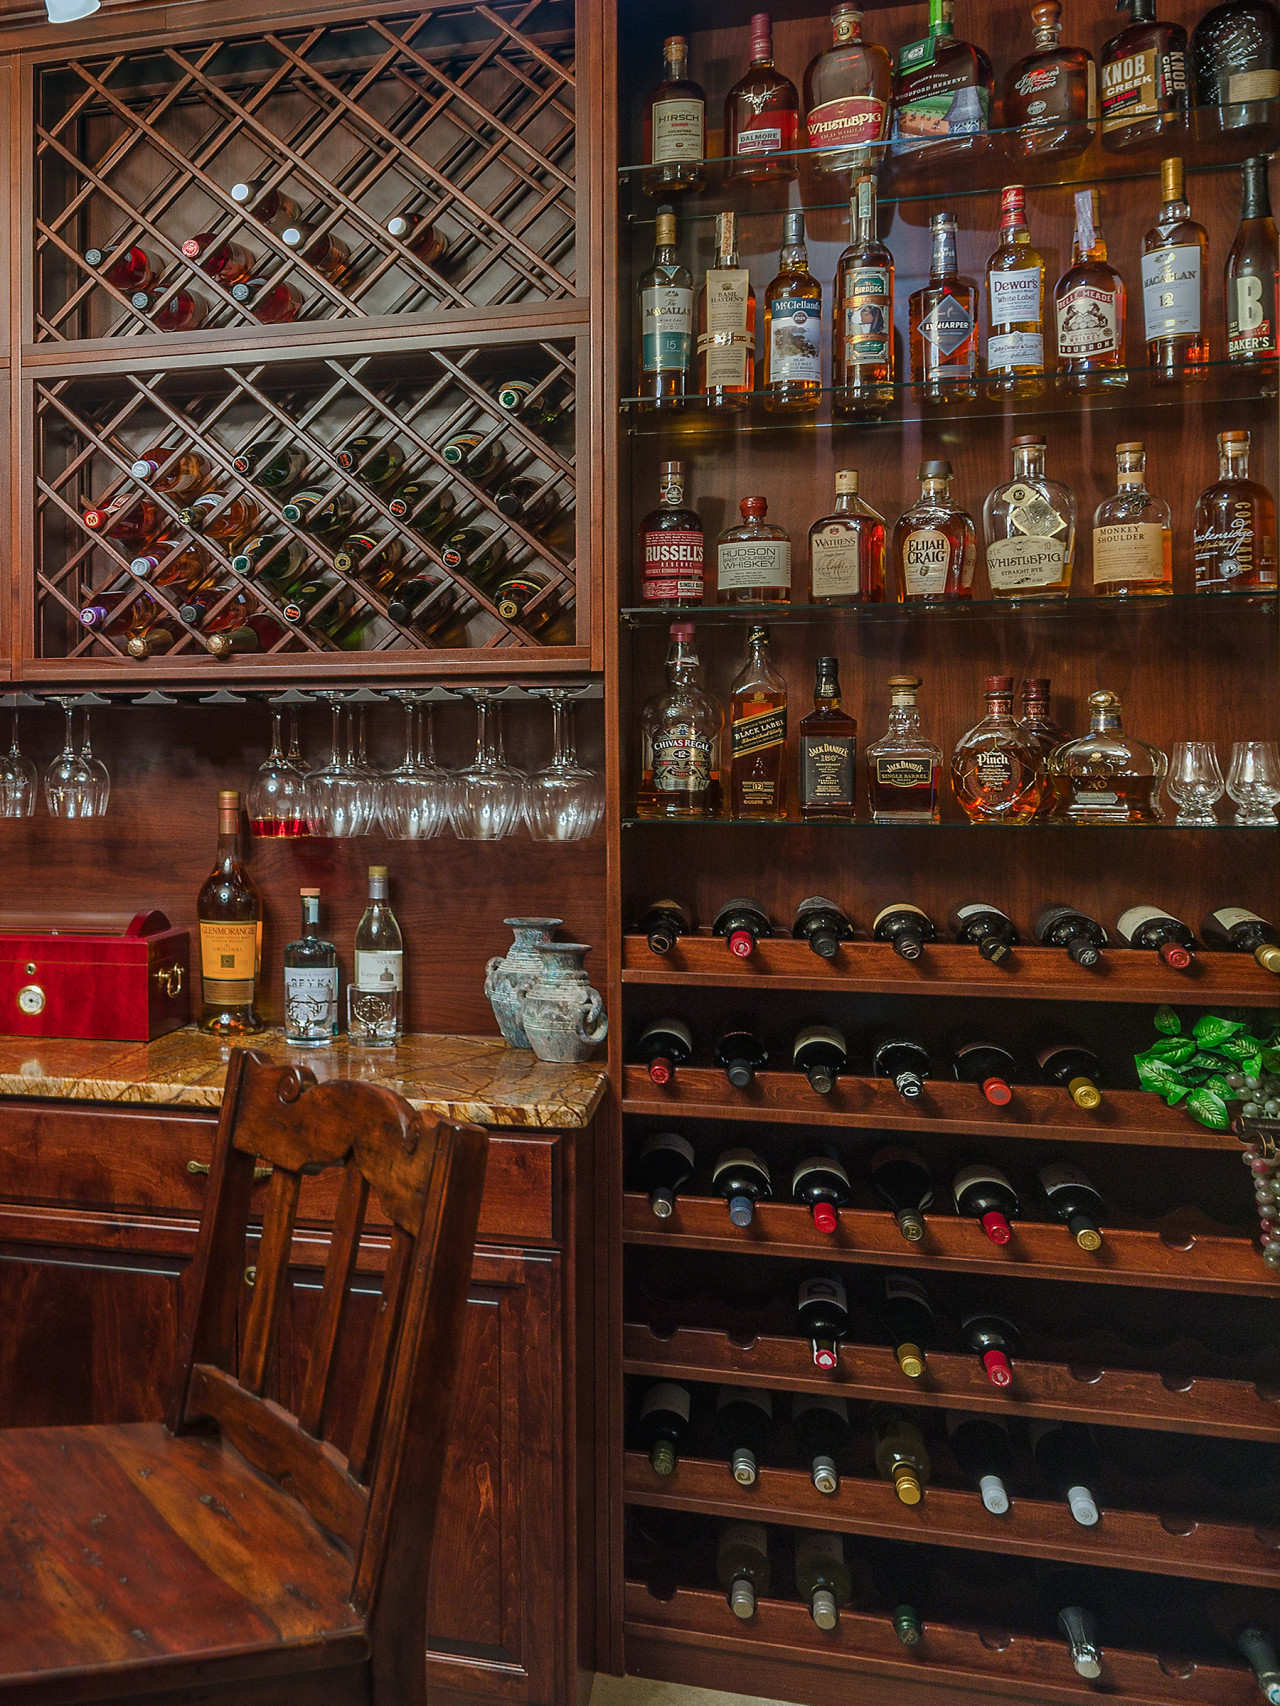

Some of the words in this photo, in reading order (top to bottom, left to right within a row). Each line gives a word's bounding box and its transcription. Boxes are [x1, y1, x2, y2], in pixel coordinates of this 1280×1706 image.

[1102, 54, 1146, 89] KNOB
[1162, 55, 1174, 96] CREEK
[1170, 51, 1187, 90] KNOB
[895, 85, 931, 101] WOODFORD
[932, 75, 969, 89] RESERVE
[1106, 74, 1153, 96] CREEK
[658, 114, 700, 123] HIRSCH
[807, 112, 881, 136] WHISTLEPIG
[740, 132, 778, 143] DALMORE
[994, 278, 1038, 293] Dewar's
[1144, 270, 1198, 288] MACALLAN
[1082, 290, 1112, 302] MEADE
[1160, 292, 1174, 307] 12
[1237, 276, 1264, 331] B
[939, 321, 969, 329] HARPER
[1069, 334, 1101, 342] WHISKEY
[1229, 336, 1270, 353] BAKER'S
[666, 340, 677, 350] 15
[1061, 340, 1111, 353] BOURBON
[1100, 525, 1140, 536] MONKEY
[1097, 533, 1145, 544] SHOULDER
[908, 539, 945, 552] ELIJAH
[645, 545, 704, 562] RUSSELL'S
[722, 547, 776, 558] HUDSON
[907, 550, 946, 564] CRAIG
[723, 560, 775, 570] WHISKEY
[987, 552, 1062, 569] WHISTLEPIG
[1001, 568, 1030, 577] STRAIGHT
[1030, 566, 1044, 574] RYE
[734, 726, 760, 740] BLACK
[761, 719, 785, 732] LABEL
[654, 739, 684, 751] CHIVAS
[684, 739, 710, 752] REGAL
[808, 745, 825, 757] JACK
[824, 743, 849, 758] DANIEL'S
[678, 750, 686, 758] 12
[976, 752, 1010, 766] Pinch
[886, 762, 901, 773] JACK
[901, 760, 924, 773] DANIEL'S
[201, 925, 256, 935] GLENMORANGIE
